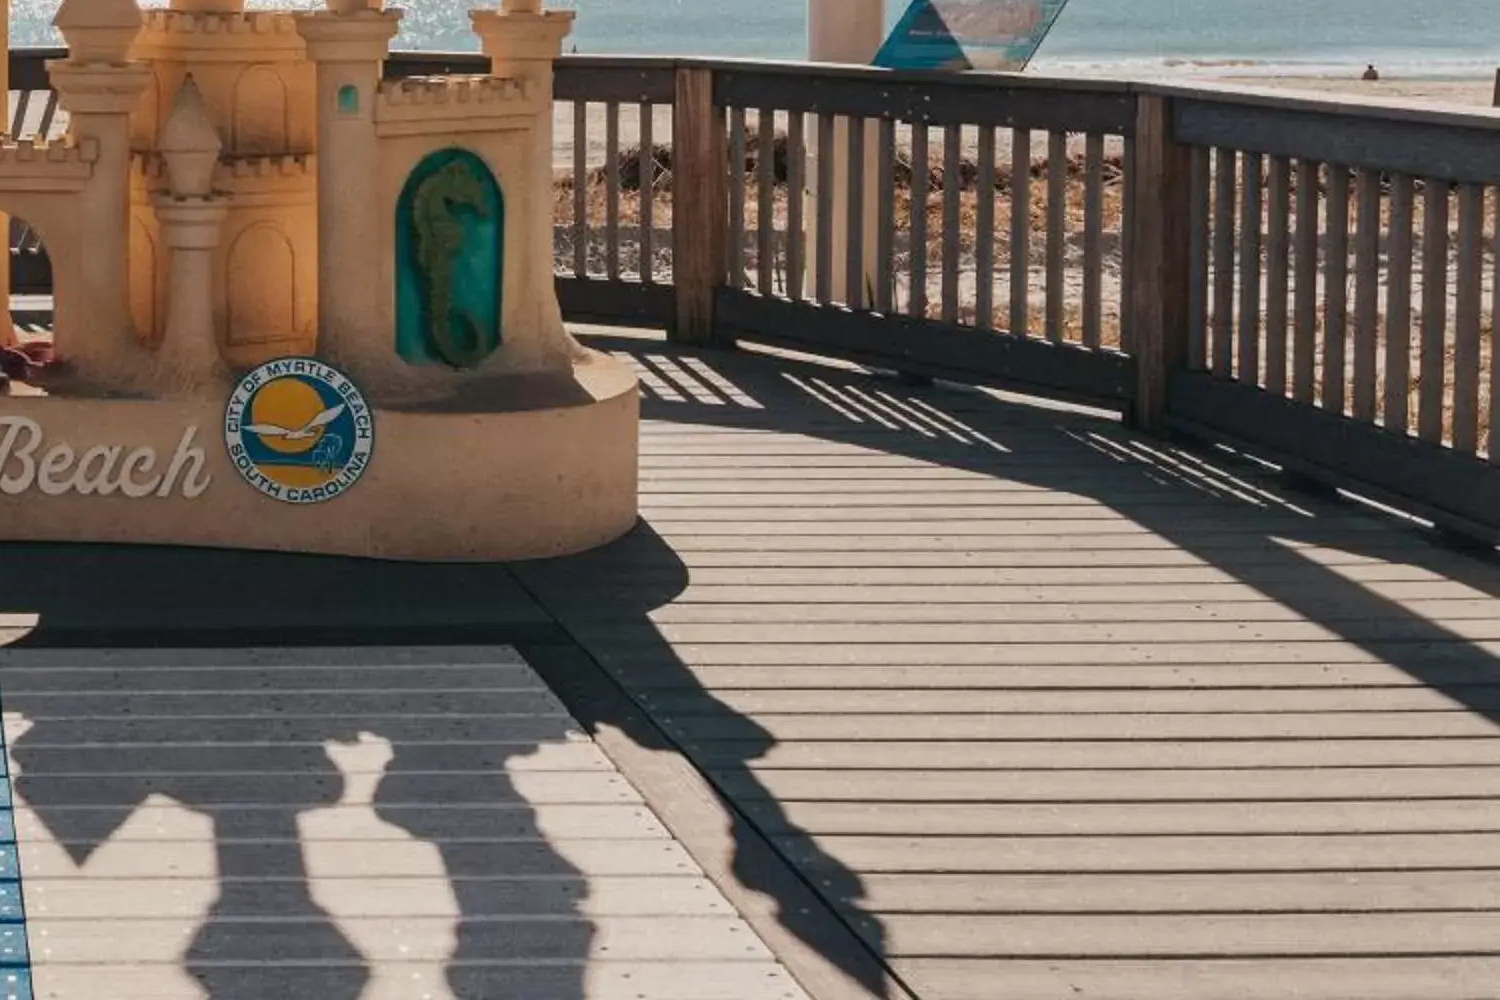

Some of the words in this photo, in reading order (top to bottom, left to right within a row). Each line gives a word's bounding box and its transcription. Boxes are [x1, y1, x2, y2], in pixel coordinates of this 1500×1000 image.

[228, 395, 245, 433] CITY
[243, 374, 261, 393] OF
[266, 360, 336, 383] MYRTLE
[337, 381, 370, 439] BEACH
[230, 443, 282, 496] SOUTH
[287, 451, 367, 501] CAROLINA
